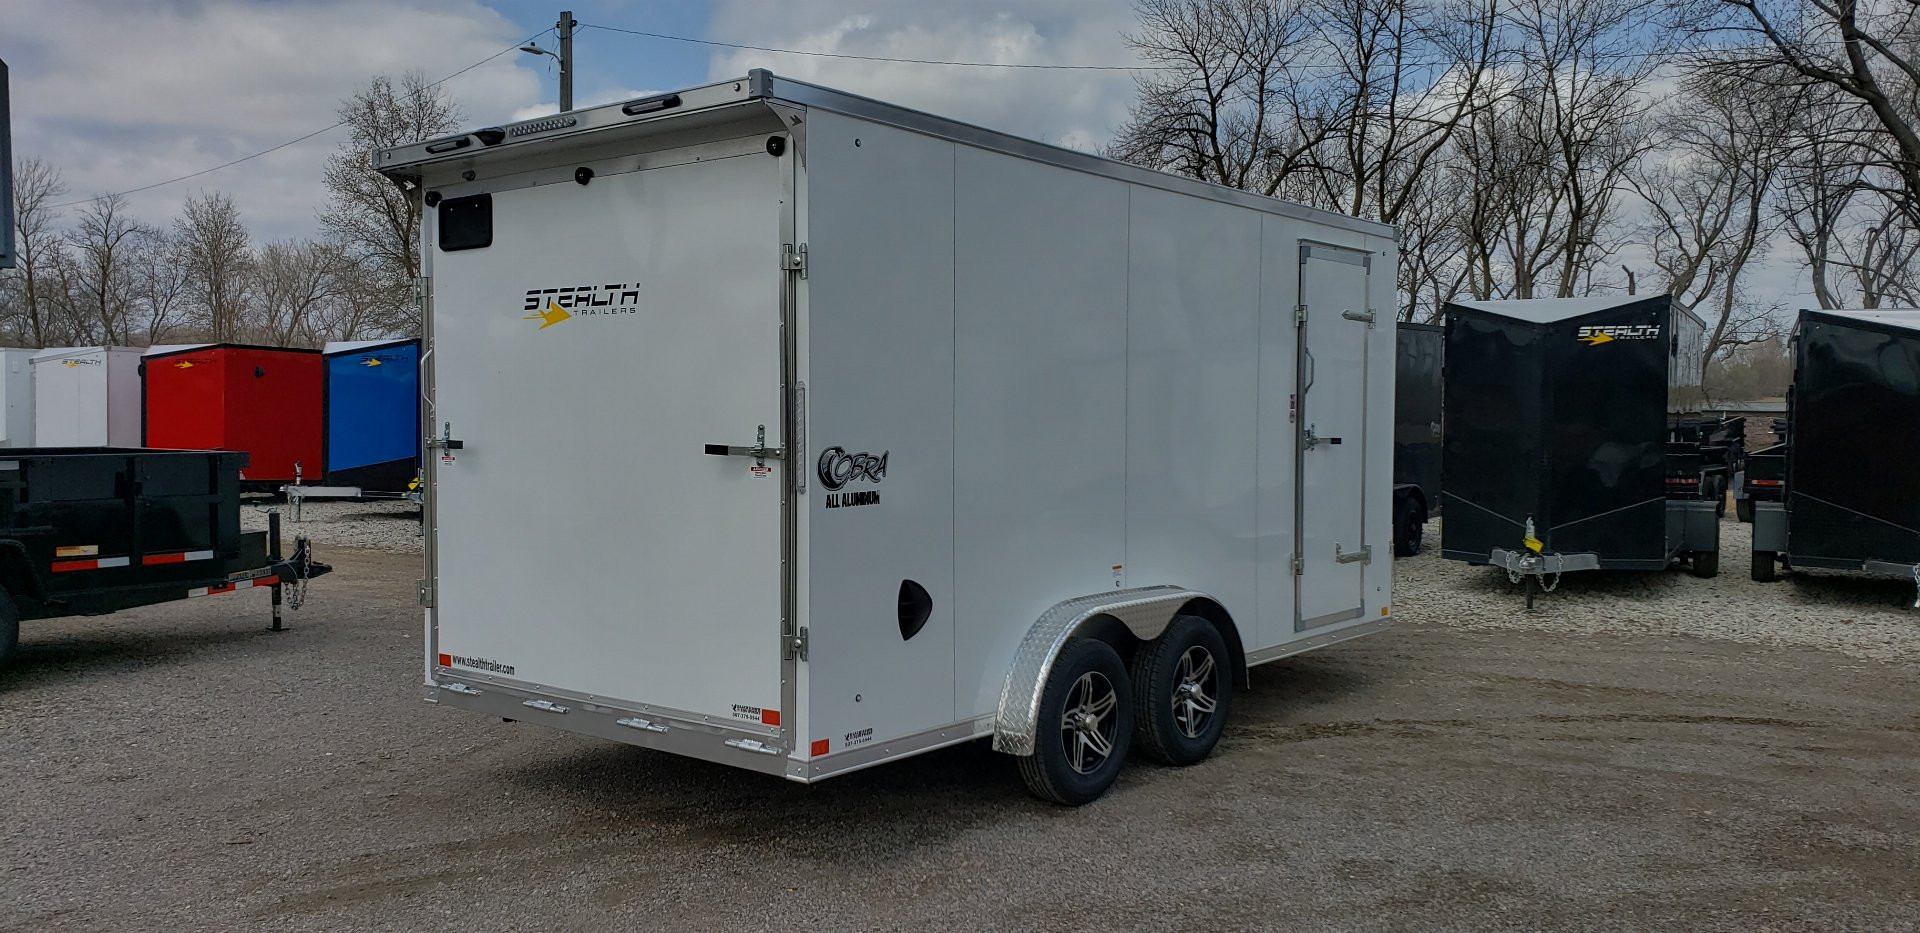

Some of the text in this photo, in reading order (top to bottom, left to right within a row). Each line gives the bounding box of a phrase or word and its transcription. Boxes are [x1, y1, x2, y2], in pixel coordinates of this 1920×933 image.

[524, 283, 640, 310] STEALTH
[574, 307, 636, 316] TRAILERS
[1578, 325, 1661, 337] STEALTH
[62, 358, 102, 366] STEALTH
[817, 446, 889, 491] COBRA
[826, 491, 880, 508] ALL ALUMINUM
[453, 655, 514, 675] www.stealthtrailer.com
